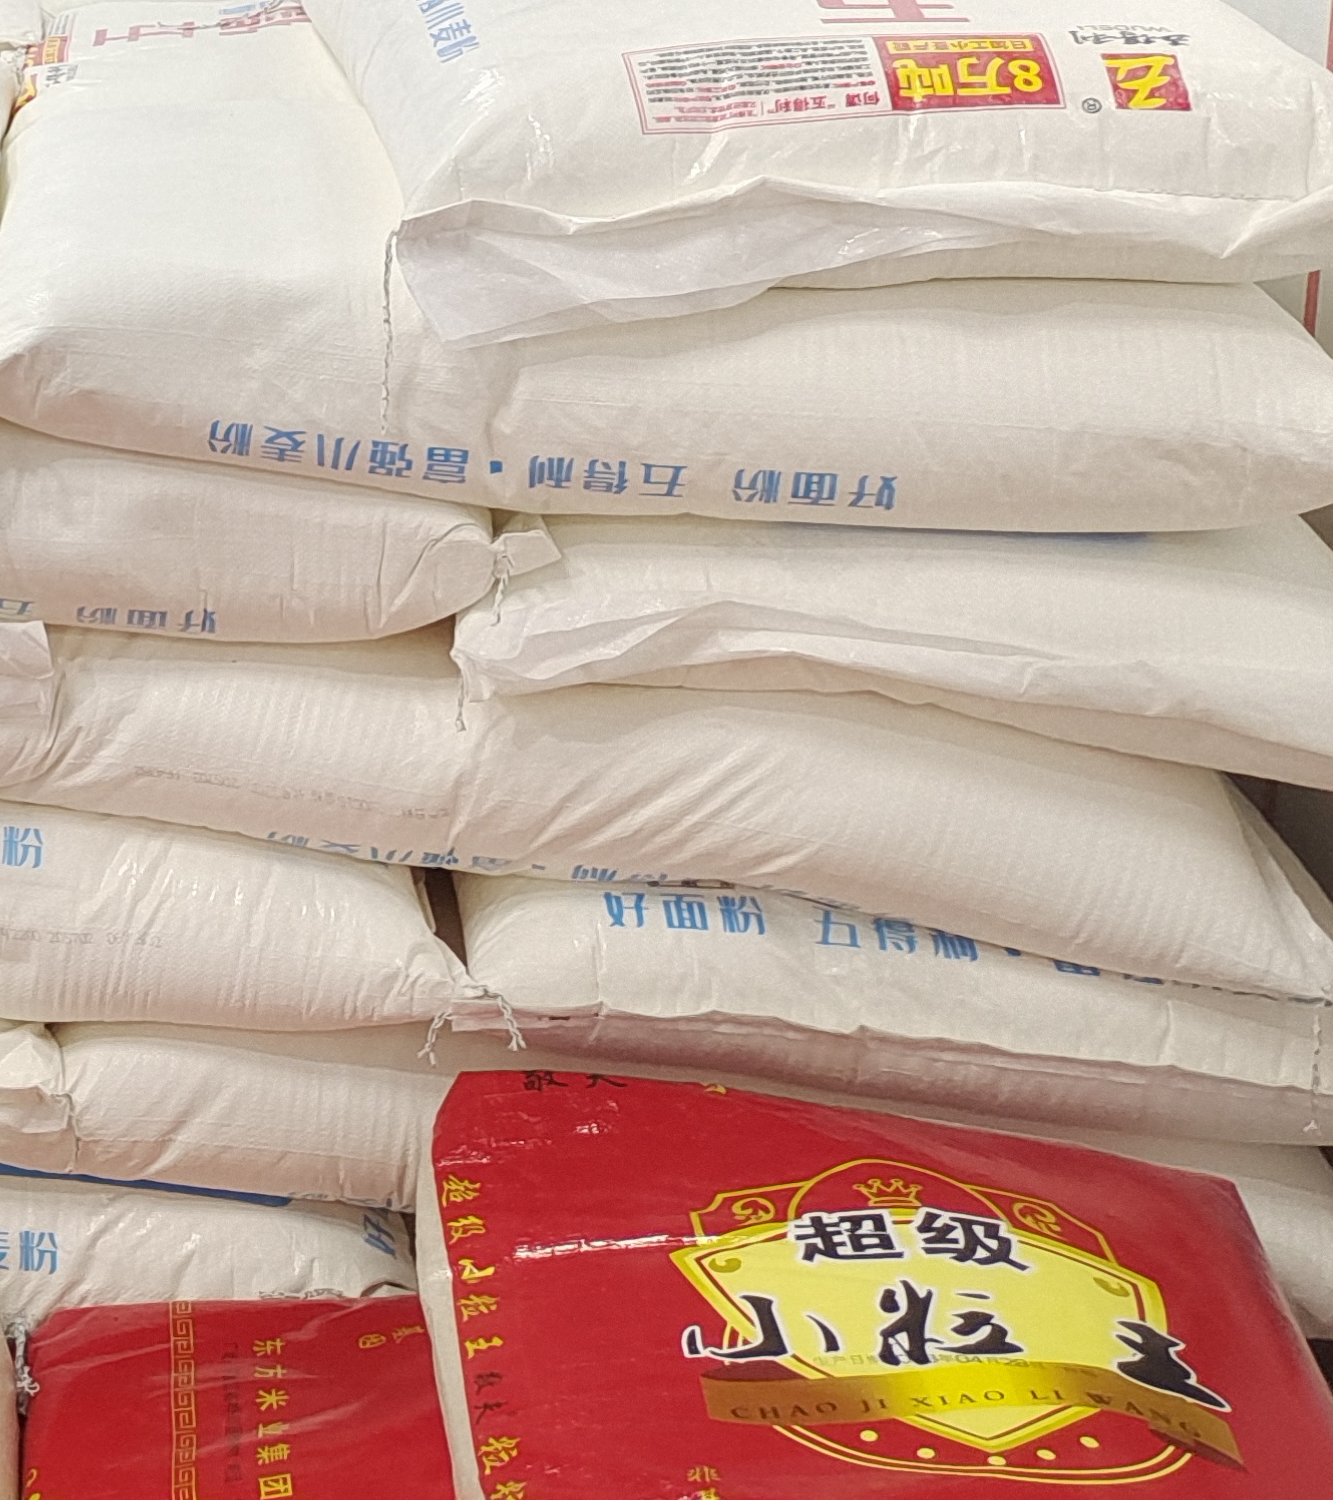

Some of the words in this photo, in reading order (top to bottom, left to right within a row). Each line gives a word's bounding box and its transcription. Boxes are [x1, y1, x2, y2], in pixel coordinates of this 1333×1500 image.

[891, 56, 1043, 104] 8万吨
[730, 466, 898, 513] 好面粉
[603, 890, 767, 937] 好面粉
[792, 1211, 1030, 1271] 超级
[729, 1401, 836, 1420] CHAO
[860, 1399, 887, 1414] JI
[909, 1388, 1007, 1409] XIAO
[1030, 1388, 1066, 1402] LI
